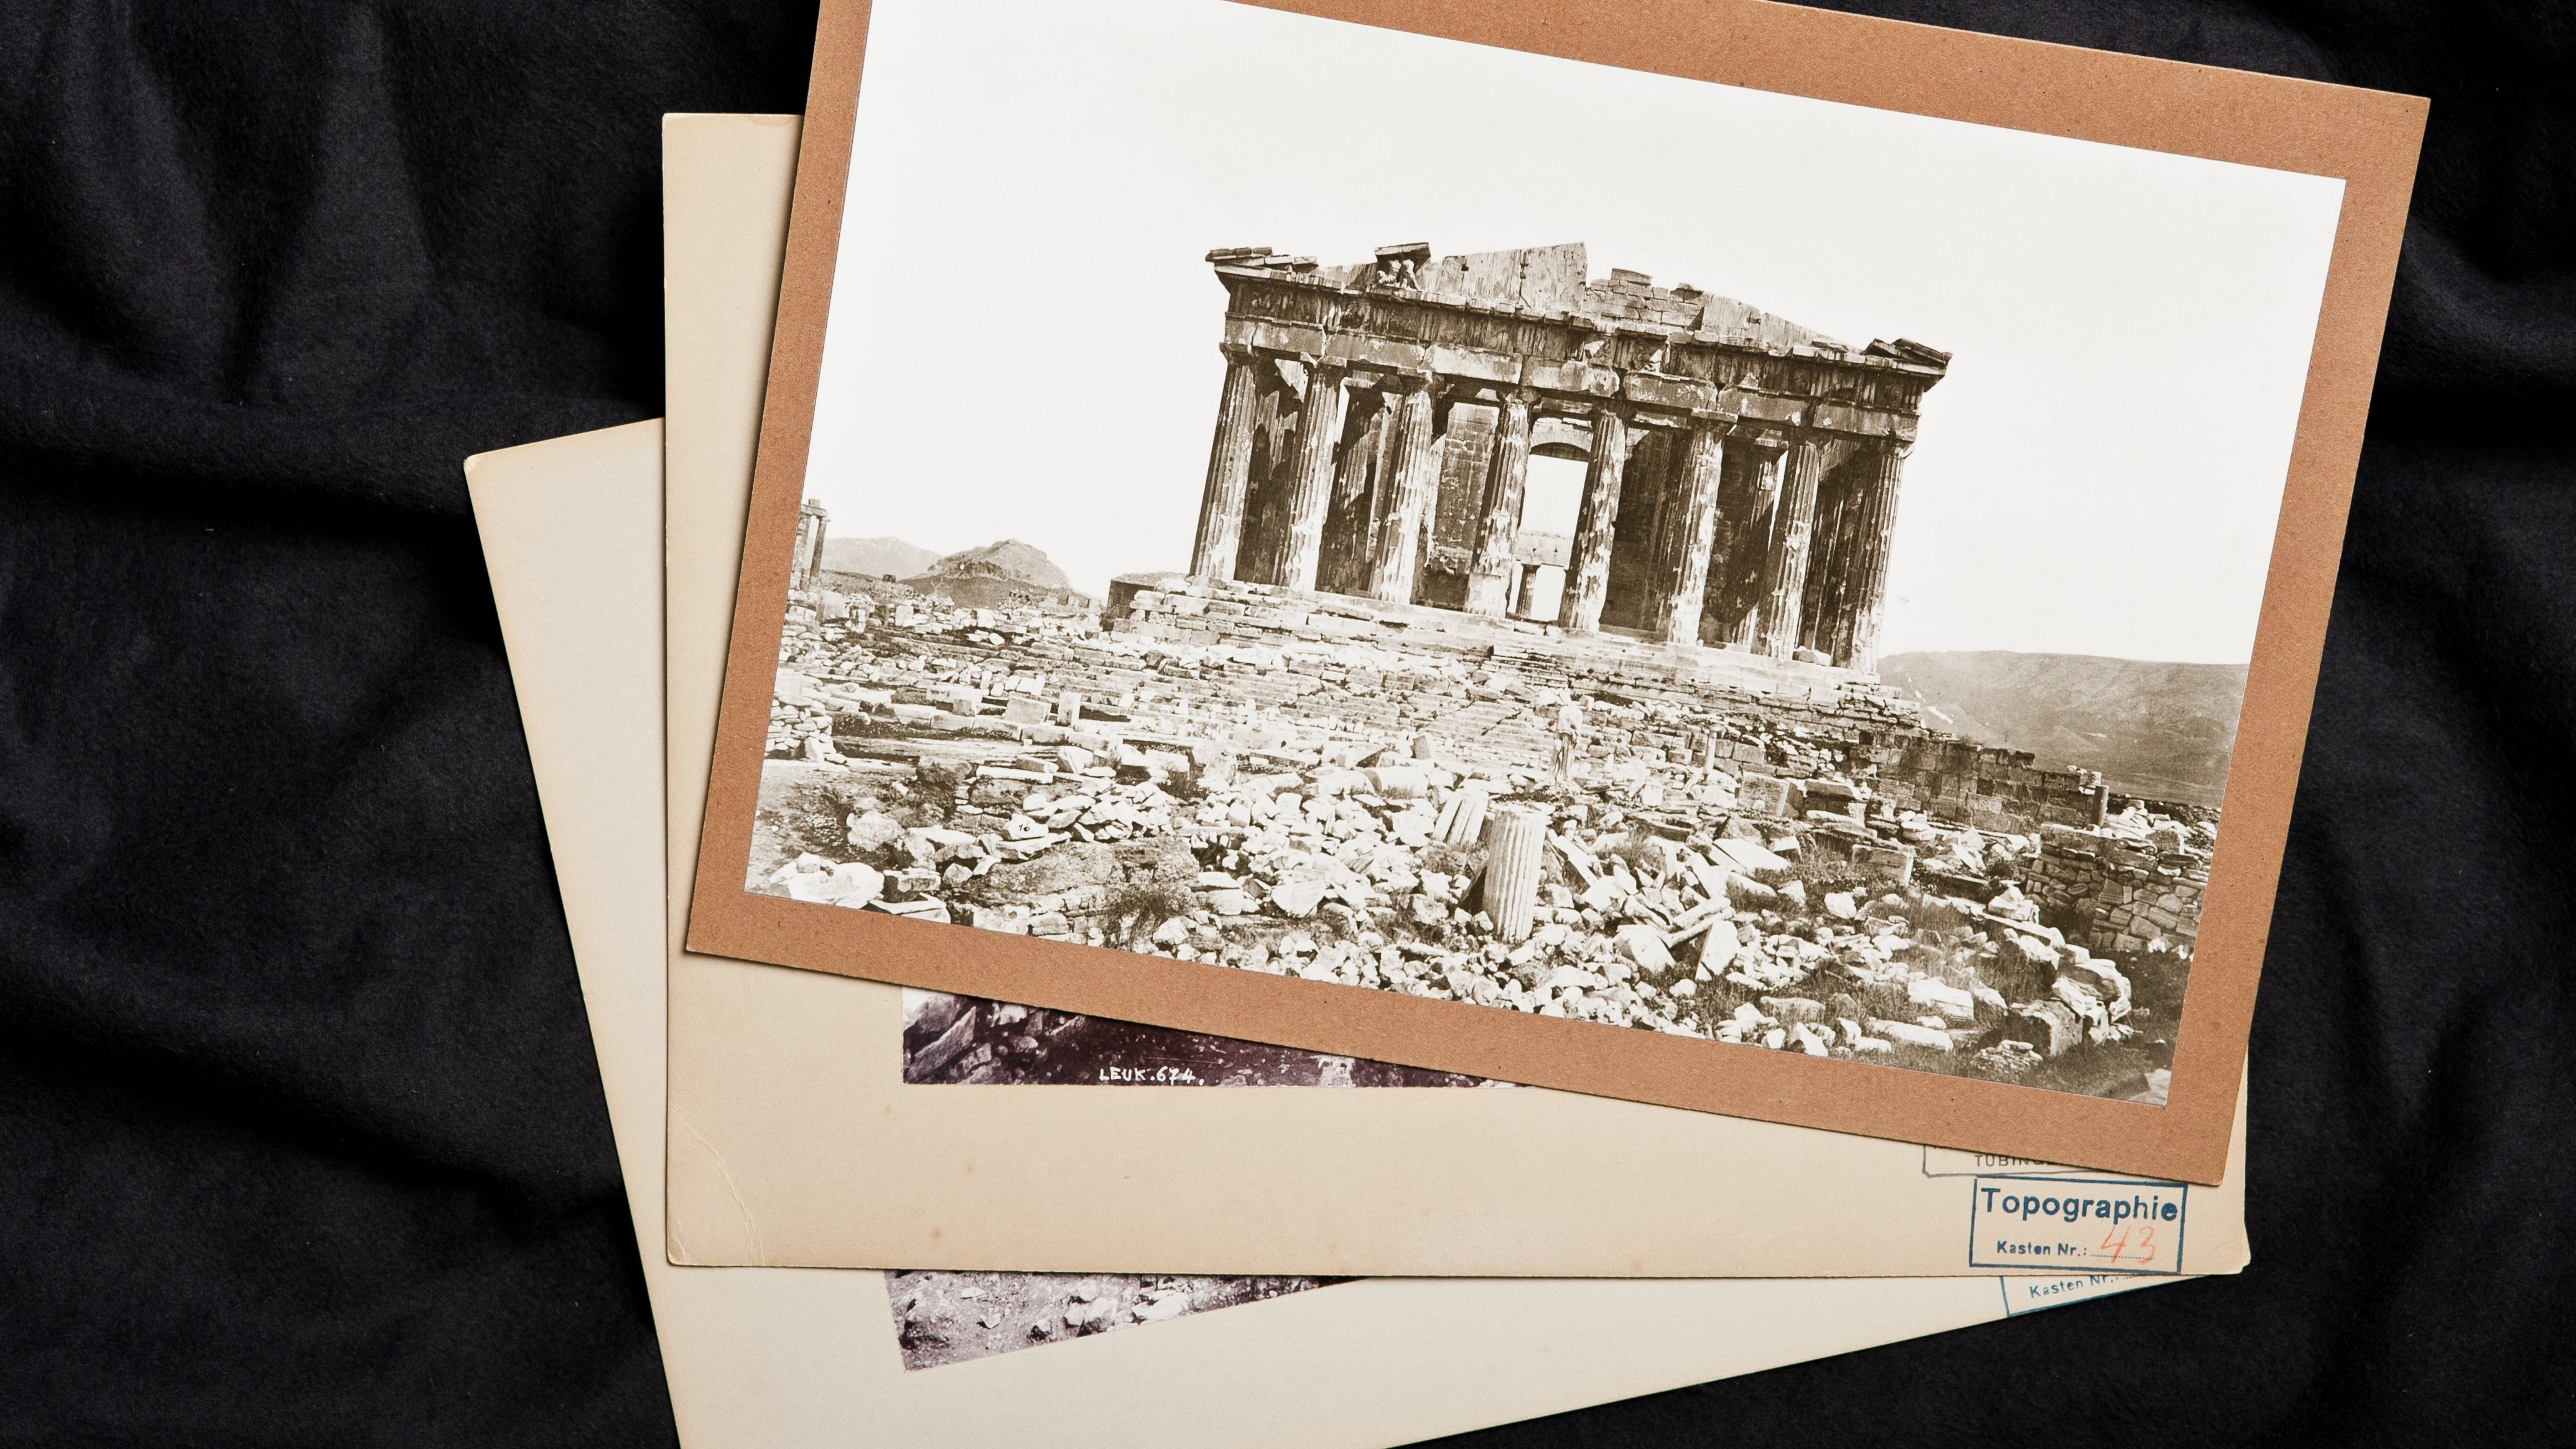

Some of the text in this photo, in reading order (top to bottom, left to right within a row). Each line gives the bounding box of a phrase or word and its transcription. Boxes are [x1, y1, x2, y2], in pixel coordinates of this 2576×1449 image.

[1981, 1187, 2178, 1225] Topographie
[1997, 1224, 2156, 1265] Kasten Nr.: 43
[2029, 1279, 2083, 1298] Kasten
